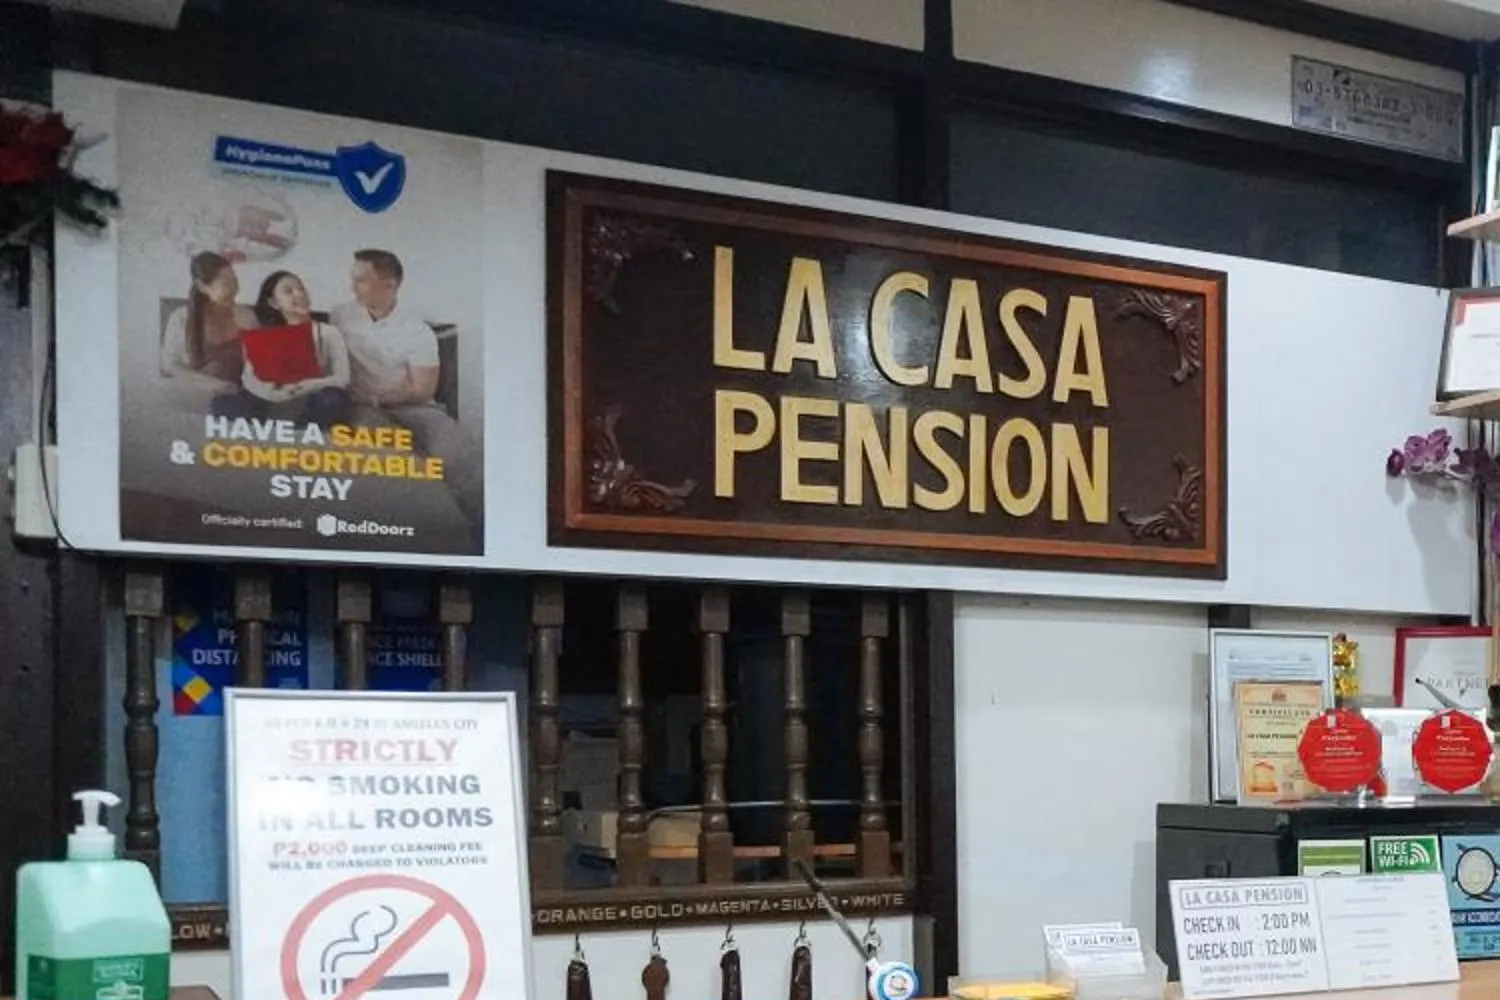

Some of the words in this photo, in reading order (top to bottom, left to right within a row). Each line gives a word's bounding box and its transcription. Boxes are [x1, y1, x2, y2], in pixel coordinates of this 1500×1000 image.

[712, 245, 837, 379] LA
[869, 271, 1110, 407] CASA
[204, 415, 296, 443] HAVE
[301, 421, 325, 446] A
[331, 424, 414, 451] SAFE
[169, 440, 196, 466] &
[202, 441, 446, 481] COMFORTABLE
[714, 389, 1110, 524] PENSION
[270, 474, 353, 501] STAY
[201, 513, 251, 529] Officially
[337, 520, 415, 537] RedDoorz
[453, 719, 479, 730] CITY
[288, 738, 459, 762] STRICTLY
[327, 773, 481, 796] SMOKING
[304, 808, 366, 831] ALL
[374, 806, 494, 830] ROOMS
[391, 842, 457, 854] CLEANING
[459, 842, 483, 852] FEE
[1377, 841, 1409, 855] FREE
[268, 861, 302, 871] WILL
[326, 858, 393, 870] CHARGED
[395, 857, 413, 867] TO
[1185, 890, 1201, 905] LA
[1204, 889, 1239, 904] CASA
[1244, 887, 1303, 902] PENSION
[536, 905, 617, 924] ORANGE
[631, 902, 684, 919] GOLD
[695, 898, 771, 916] MAGENTA
[851, 893, 905, 907] WHITE
[1183, 916, 1225, 935] CHECK
[1291, 911, 1311, 929] PM
[1187, 942, 1229, 961] CHECK
[1231, 940, 1254, 957] OUT
